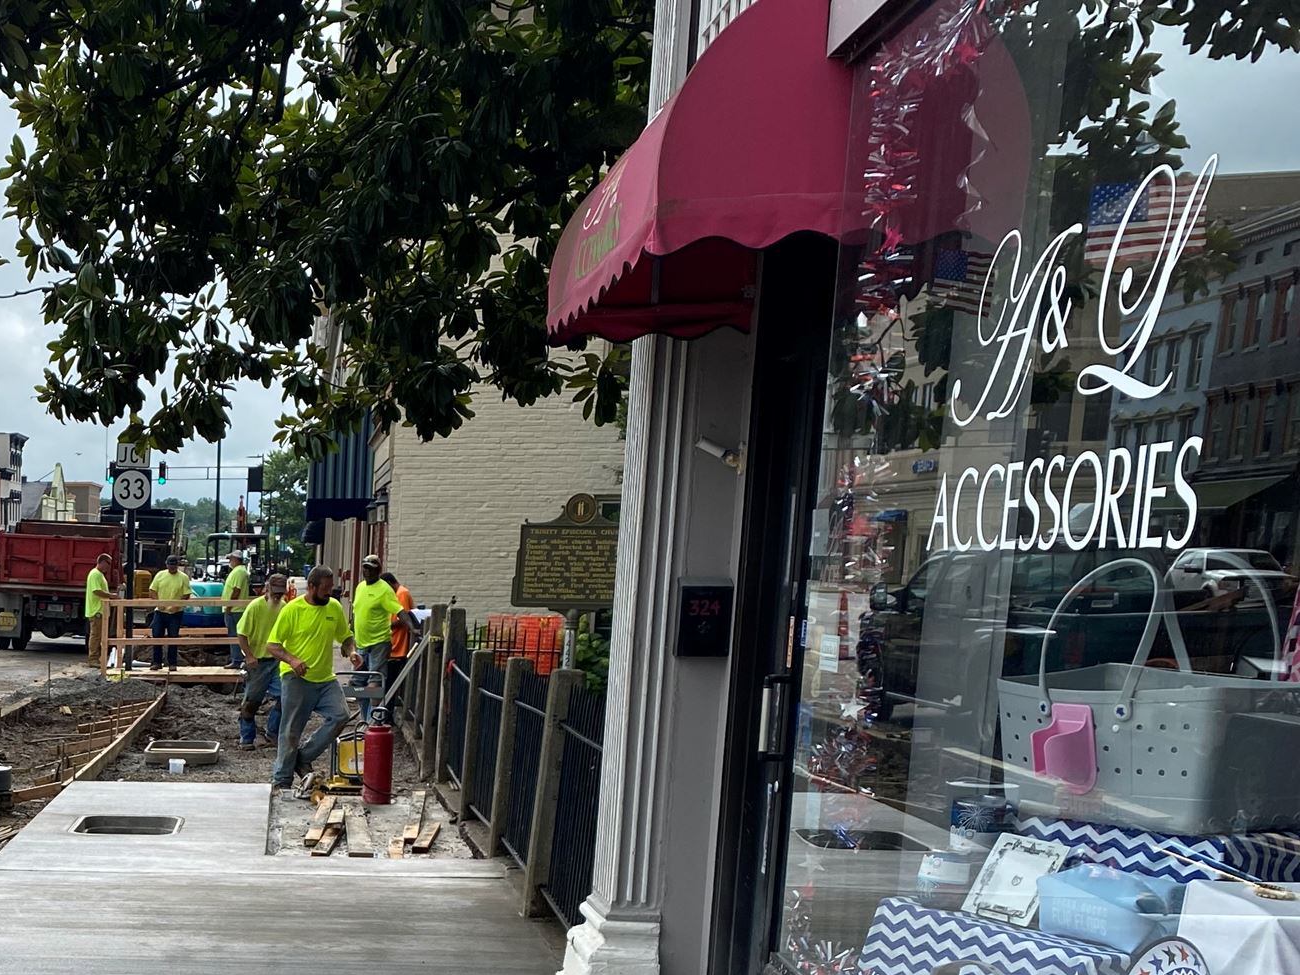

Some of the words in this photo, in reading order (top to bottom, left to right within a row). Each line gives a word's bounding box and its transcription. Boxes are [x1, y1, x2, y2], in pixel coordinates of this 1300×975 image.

[1077, 153, 1219, 399] L
[120, 478, 145, 500] 33
[926, 436, 1203, 551] ACCESSORIES
[689, 599, 721, 616] 324
